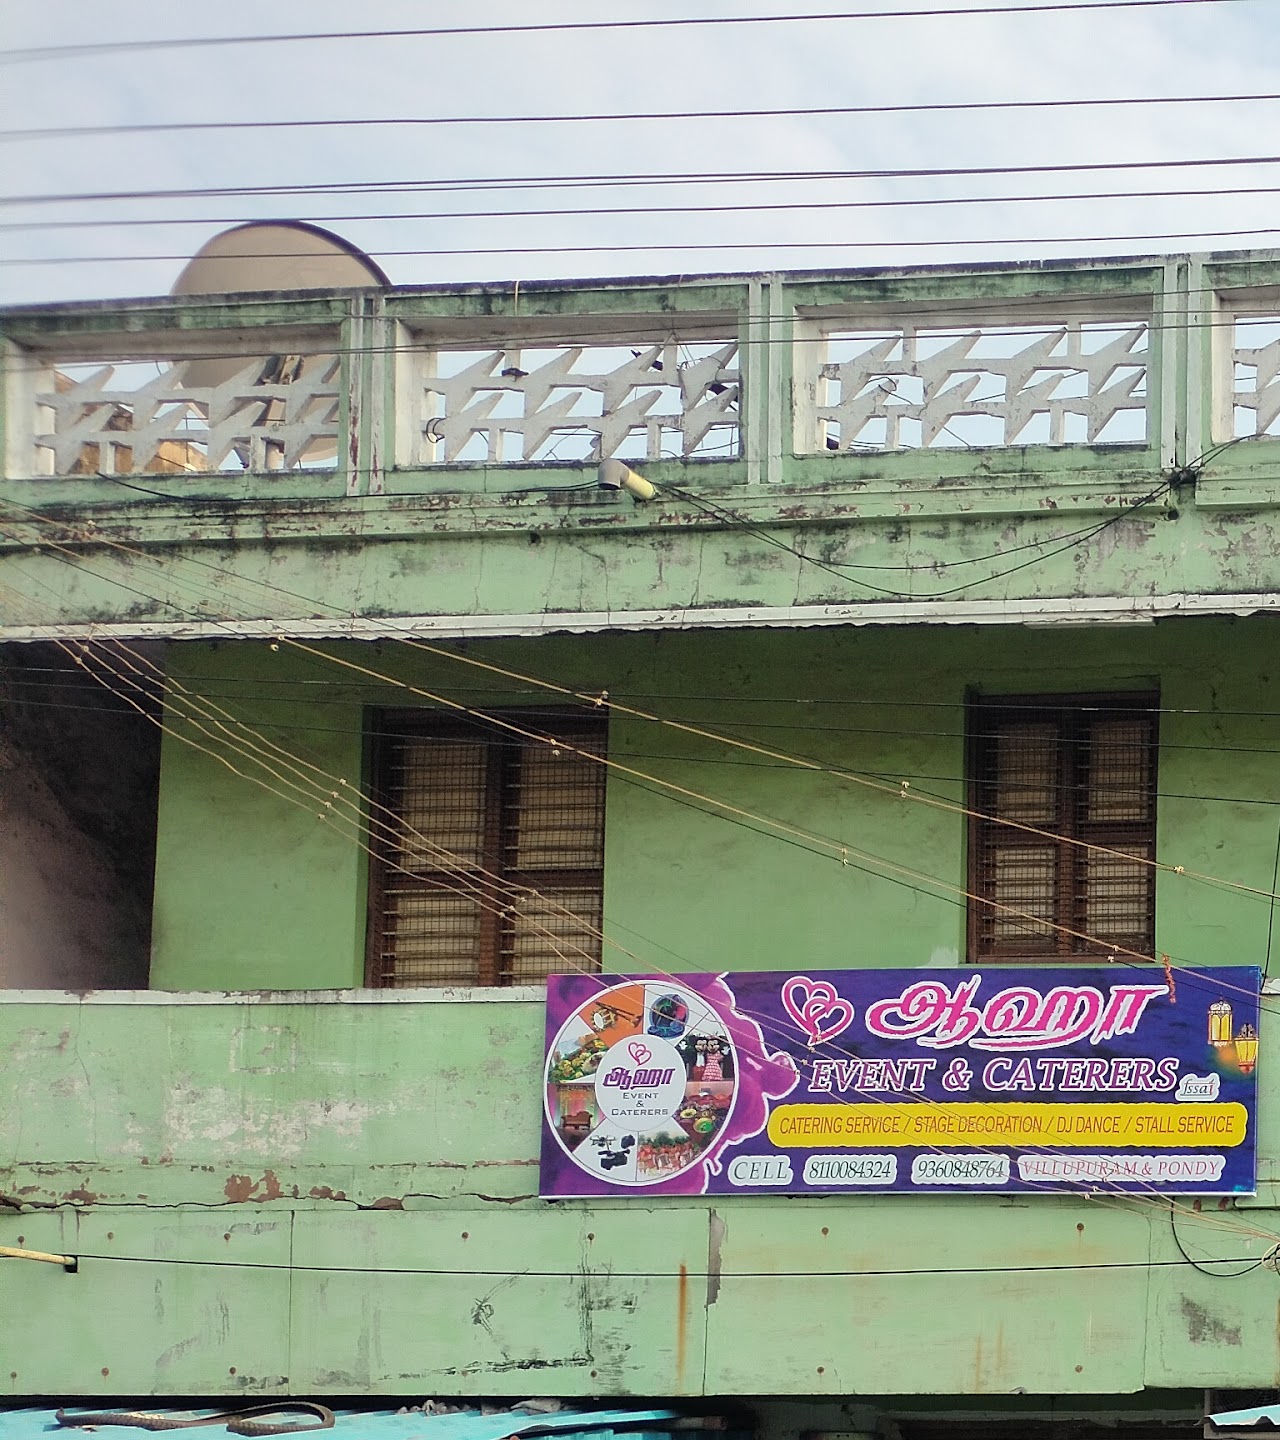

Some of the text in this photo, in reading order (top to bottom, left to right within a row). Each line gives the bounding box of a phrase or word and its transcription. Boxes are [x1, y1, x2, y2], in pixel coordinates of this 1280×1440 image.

[867, 975, 1168, 1051] ஆஹா
[809, 1057, 1180, 1092] EVENT & CATERERS
[780, 1117, 842, 1134] CATERING
[845, 1116, 900, 1134] SERVICE
[914, 1116, 954, 1134] STAGE
[958, 1115, 1042, 1134] DECORATION
[1056, 1116, 1073, 1134] DJ
[1076, 1116, 1120, 1134] DANCE
[1135, 1115, 1176, 1133] STALL
[1178, 1115, 1234, 1133] SERVICE
[734, 1160, 1219, 1179] CELL 8110084324 9360848764 VILLUPURAM & PONDY
